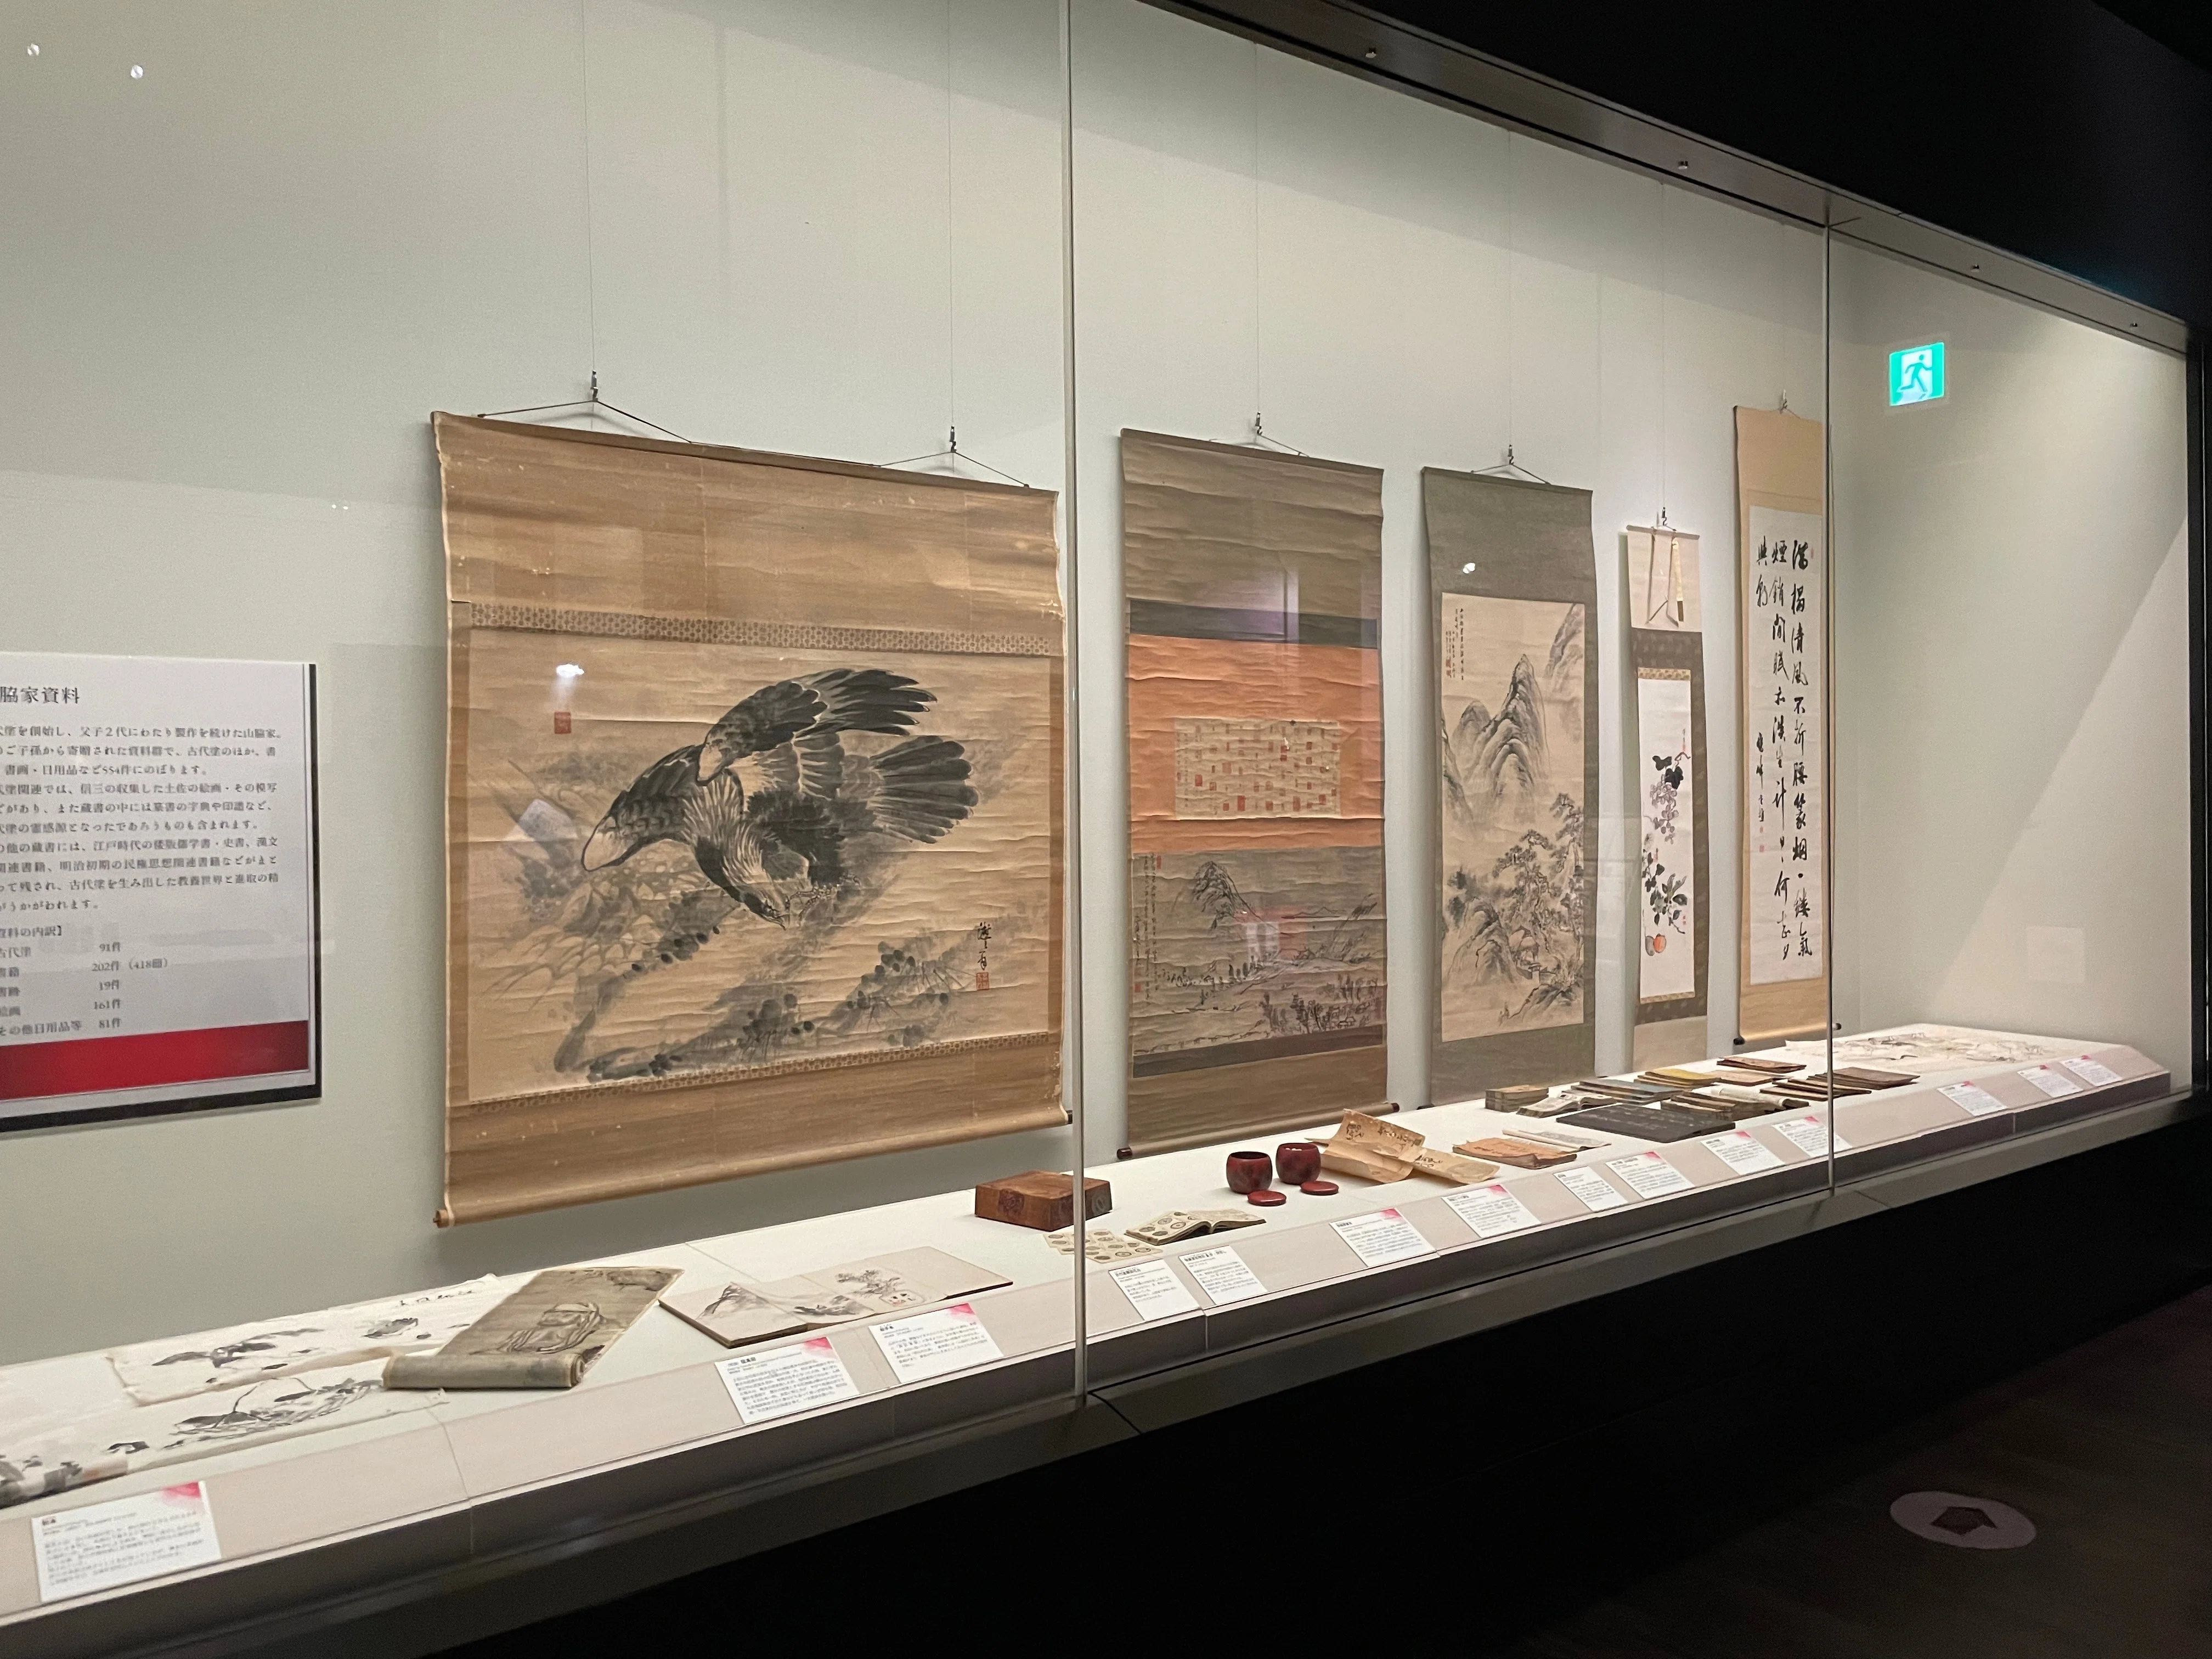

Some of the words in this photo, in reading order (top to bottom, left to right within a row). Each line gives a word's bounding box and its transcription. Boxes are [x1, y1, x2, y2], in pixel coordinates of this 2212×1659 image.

[99, 942, 121, 952] 91件
[99, 979, 119, 991] 19件
[99, 1018, 121, 1029] 81件
